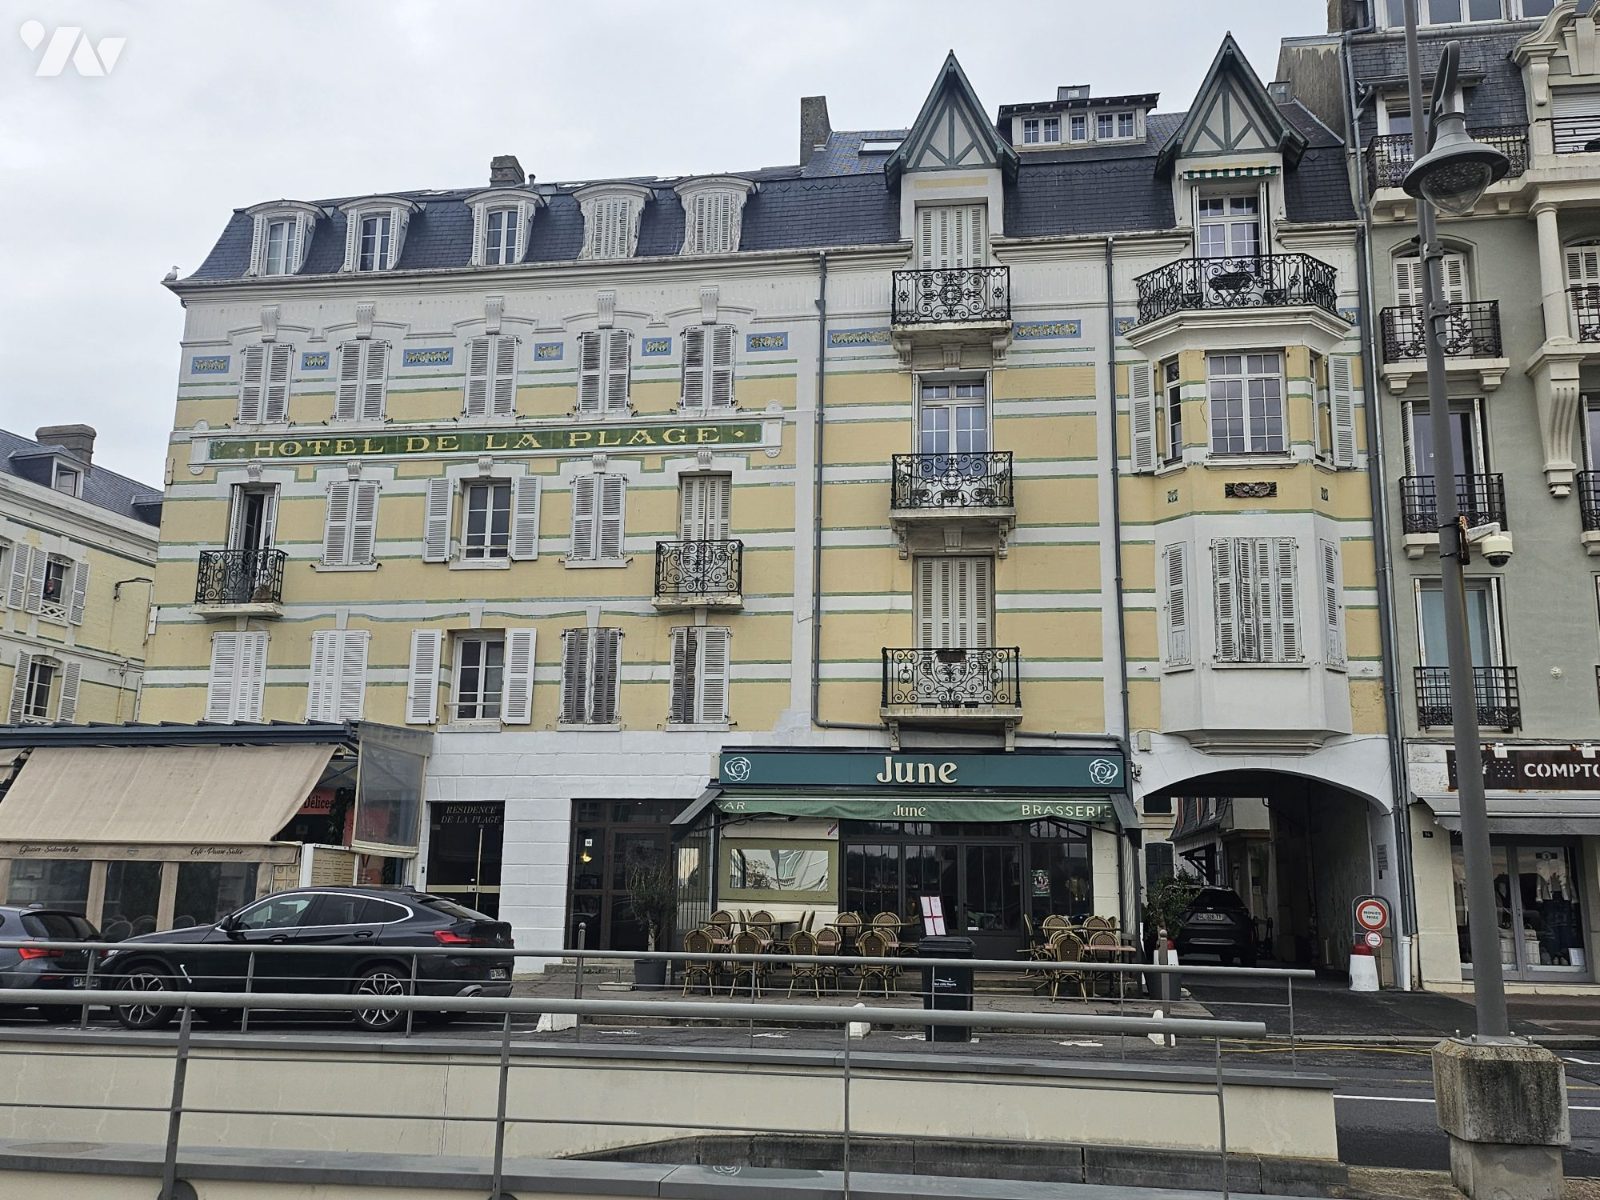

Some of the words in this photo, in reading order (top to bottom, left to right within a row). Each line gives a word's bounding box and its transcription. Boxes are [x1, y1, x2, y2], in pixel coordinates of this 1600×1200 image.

[254, 438, 384, 457] HOTEL
[406, 436, 459, 452] DE
[485, 433, 542, 450] LA
[568, 427, 720, 448] PLAGE
[876, 756, 958, 784] June
[446, 805, 497, 814] RESIDENCE
[892, 804, 927, 817] June
[1021, 804, 1112, 818] BRASSERIE
[441, 815, 453, 824] DE
[456, 815, 468, 823] LA
[471, 815, 501, 824] PLAGE
